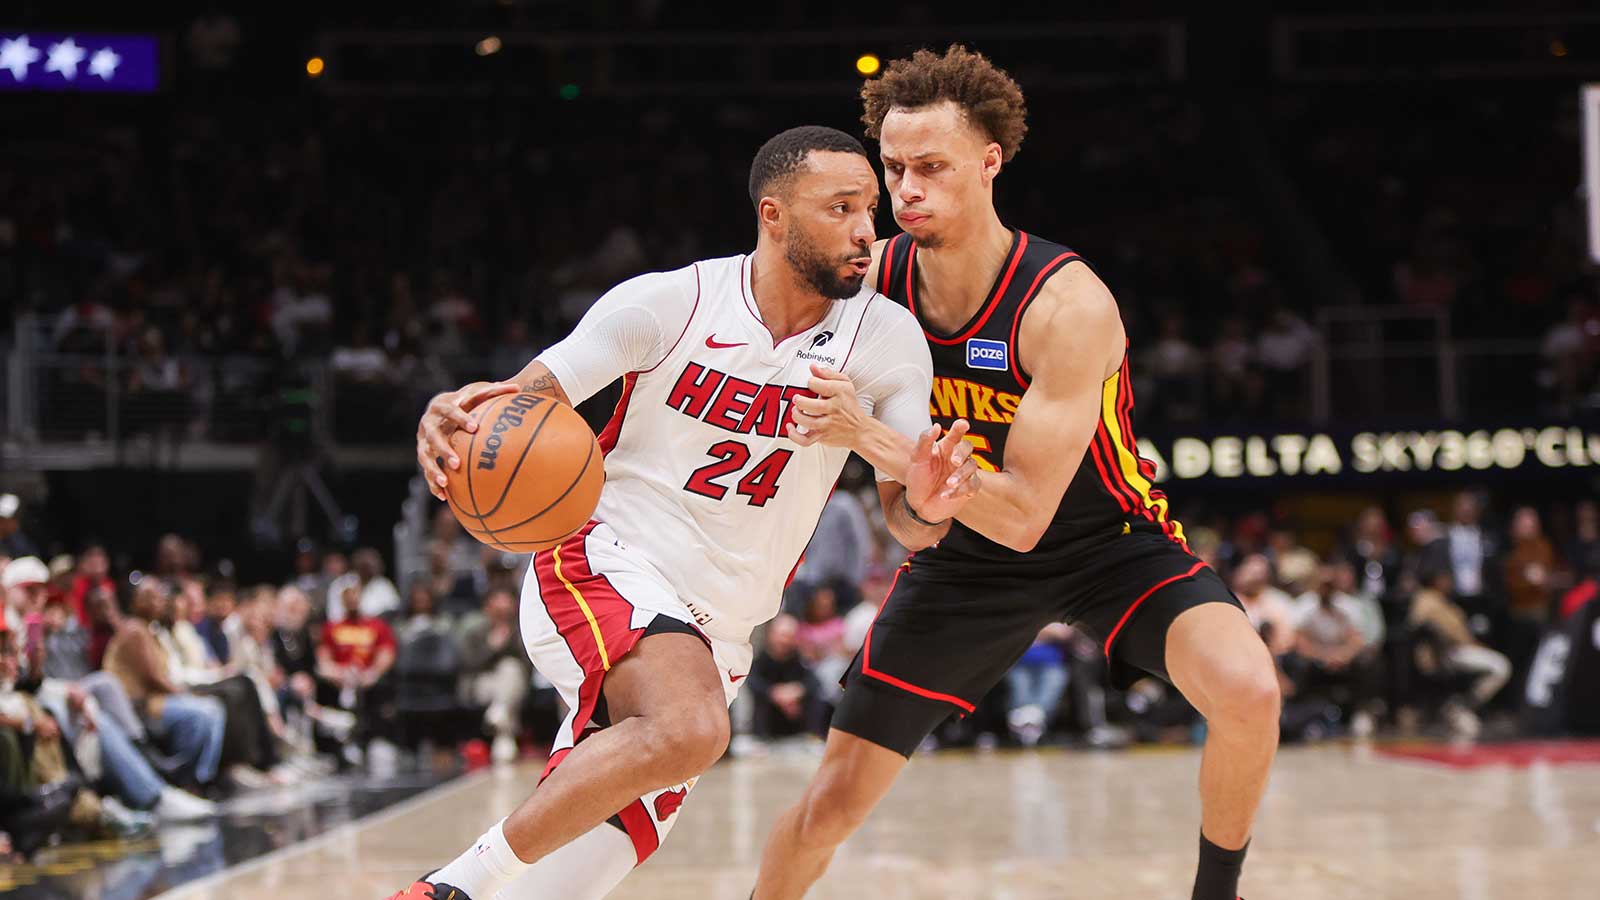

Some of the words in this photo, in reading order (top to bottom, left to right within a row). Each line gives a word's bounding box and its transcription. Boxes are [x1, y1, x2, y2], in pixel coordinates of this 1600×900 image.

[970, 346, 1004, 361] paze
[929, 376, 1022, 424] WKS
[477, 393, 546, 471] Wilson
[683, 439, 794, 507] 24
[1173, 434, 1342, 479] DELTA
